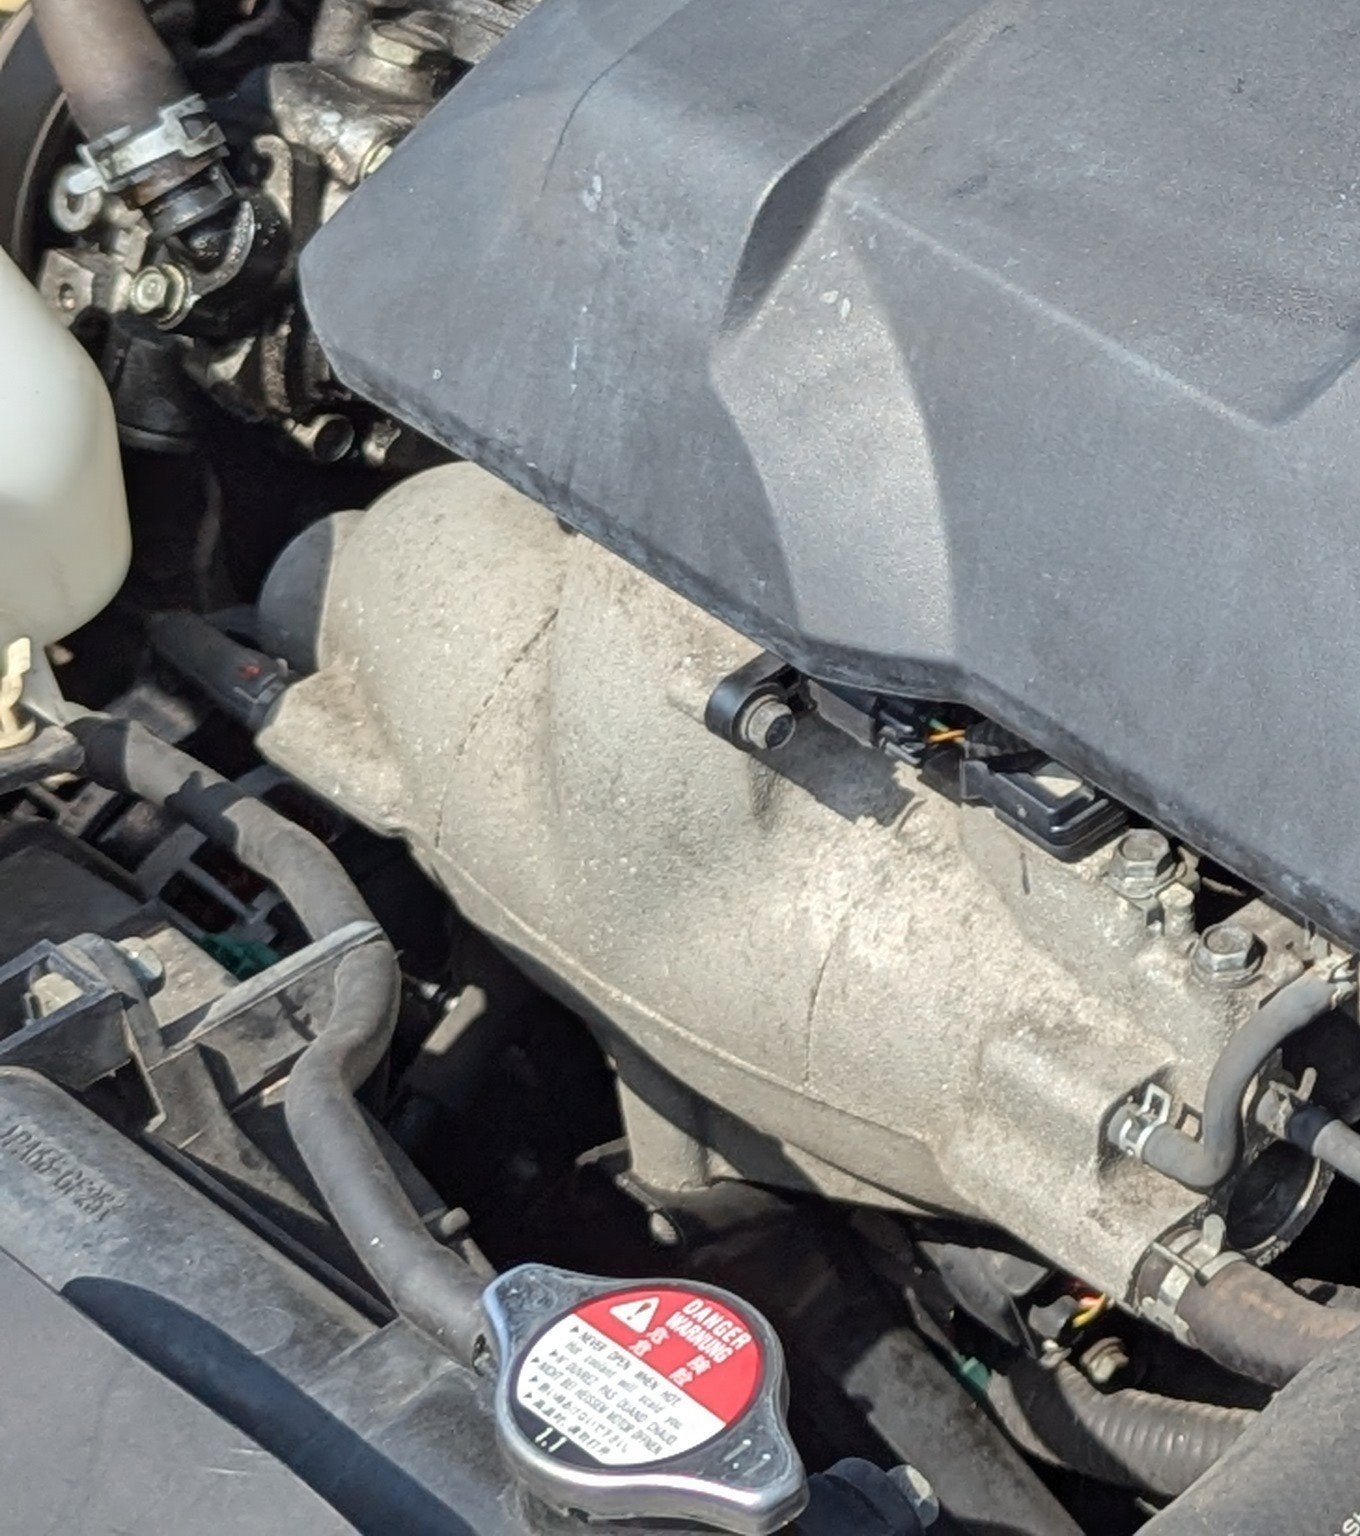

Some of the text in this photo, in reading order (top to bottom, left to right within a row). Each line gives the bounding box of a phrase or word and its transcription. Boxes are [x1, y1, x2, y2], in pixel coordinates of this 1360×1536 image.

[665, 1310, 734, 1365] WARNUNG
[682, 1296, 752, 1351] DANGER
[578, 1331, 607, 1352] NEVER
[607, 1349, 632, 1370] OPEN
[533, 1425, 566, 1454] 1.1
